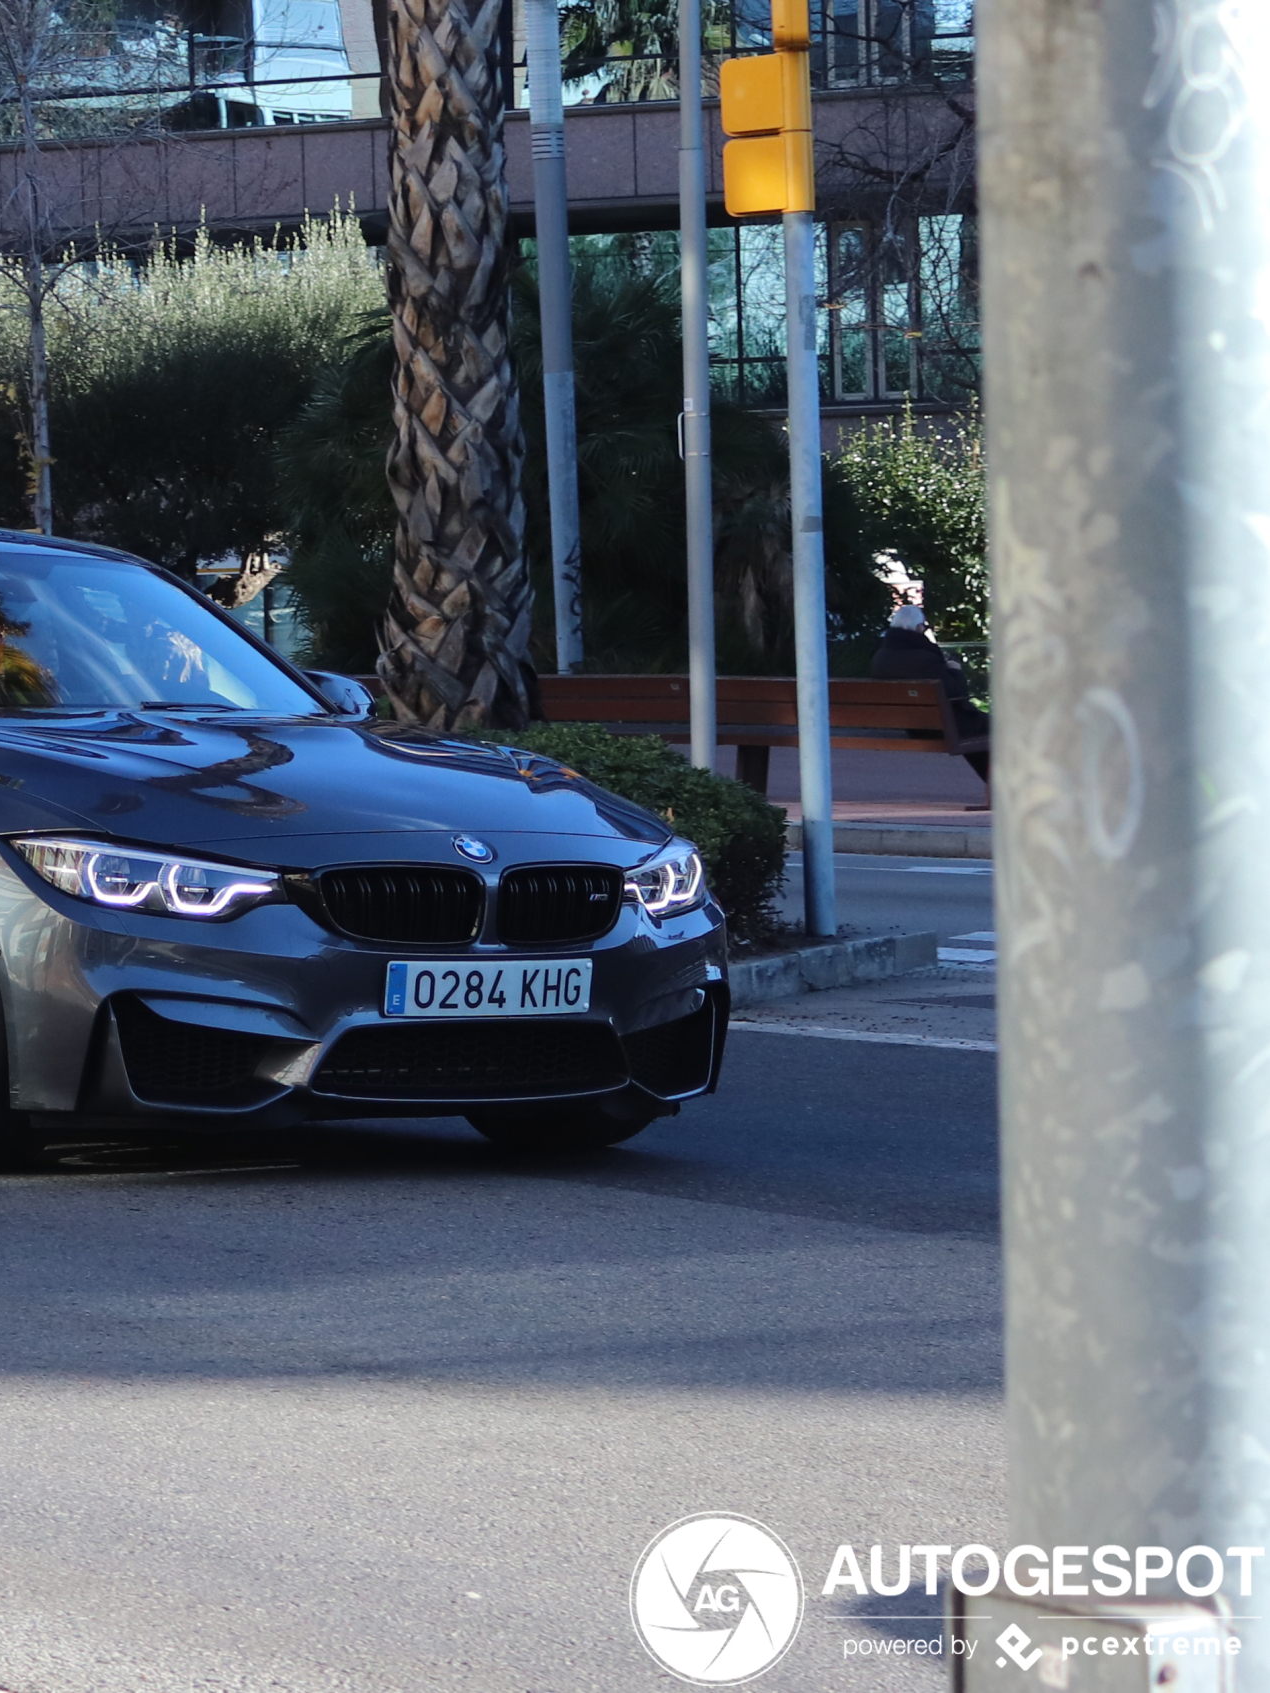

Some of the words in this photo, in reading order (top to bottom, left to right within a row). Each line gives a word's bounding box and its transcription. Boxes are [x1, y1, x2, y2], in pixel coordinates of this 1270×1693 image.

[392, 994, 400, 1006] E
[413, 969, 507, 1009] 0284
[520, 967, 582, 1009] KHG
